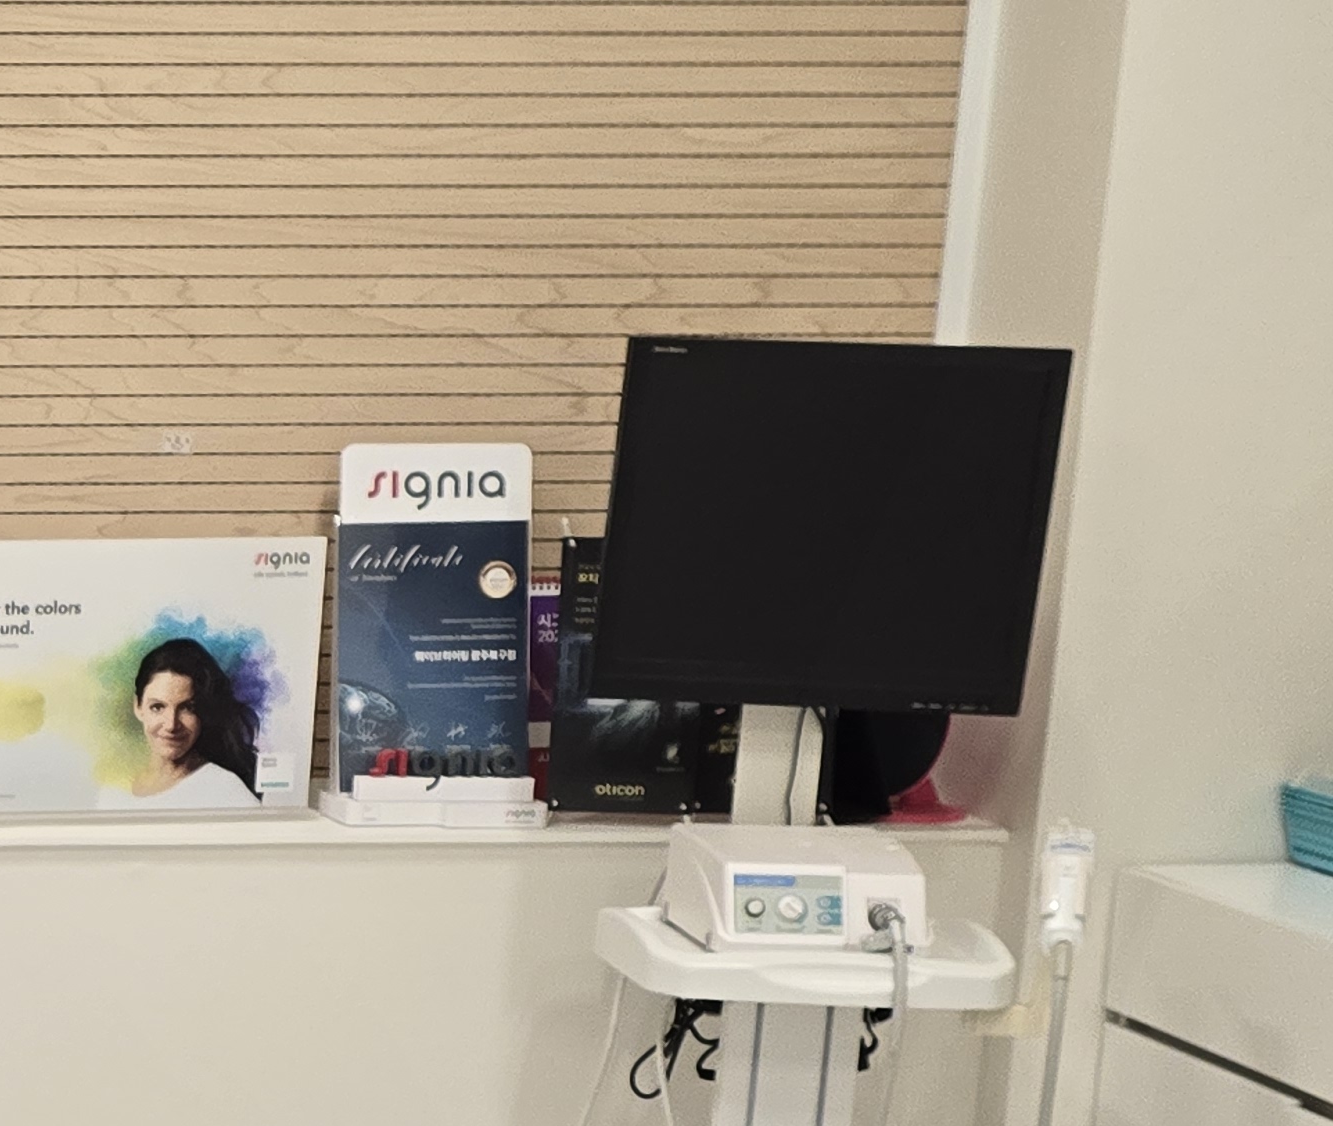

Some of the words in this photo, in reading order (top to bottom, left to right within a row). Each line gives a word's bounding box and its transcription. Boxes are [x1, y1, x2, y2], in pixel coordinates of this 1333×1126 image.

[367, 470, 506, 510] signia
[254, 551, 311, 570] signia
[4, 600, 30, 615] the
[34, 600, 81, 615] colors
[595, 784, 645, 796] oticon
